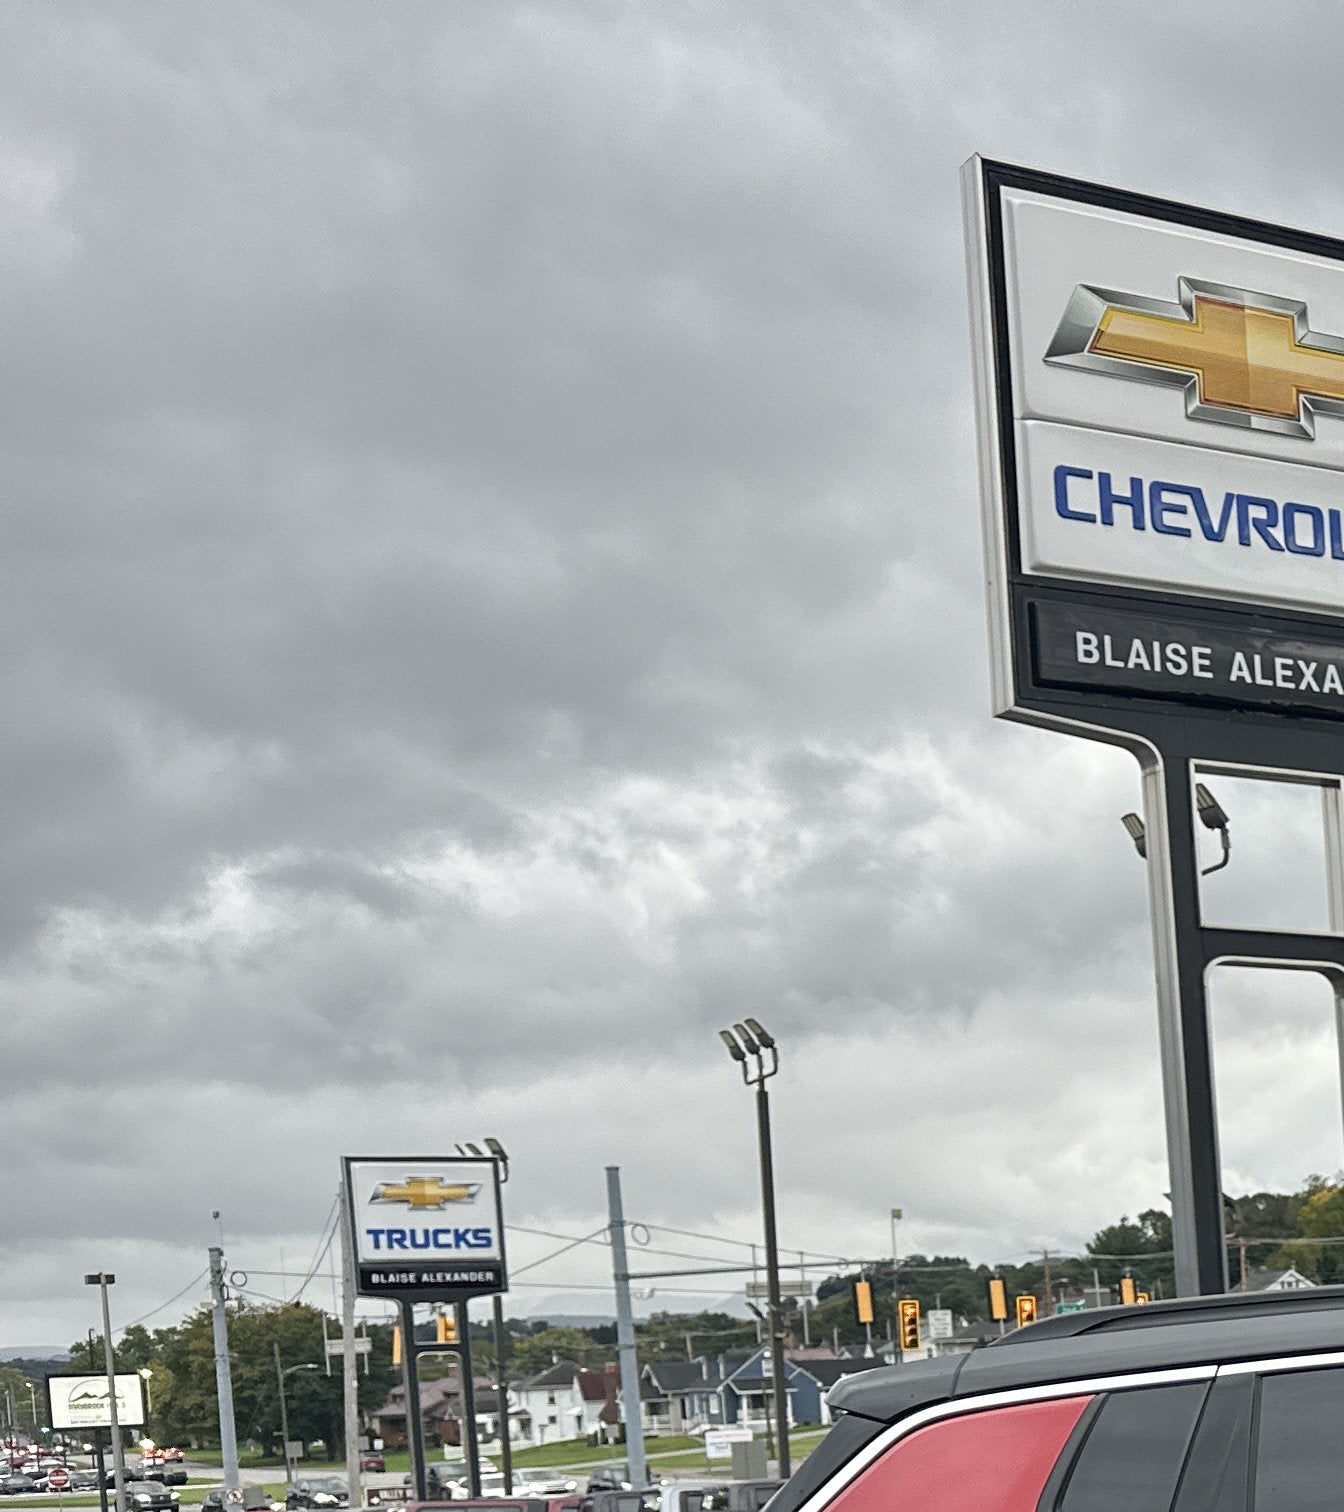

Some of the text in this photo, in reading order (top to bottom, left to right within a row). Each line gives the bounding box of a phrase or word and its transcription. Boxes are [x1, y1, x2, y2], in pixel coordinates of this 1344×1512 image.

[1075, 631, 1214, 679] BLAISE
[366, 1228, 493, 1250] TRUCKS
[371, 1271, 494, 1284] BLAISE ALEXANDER
